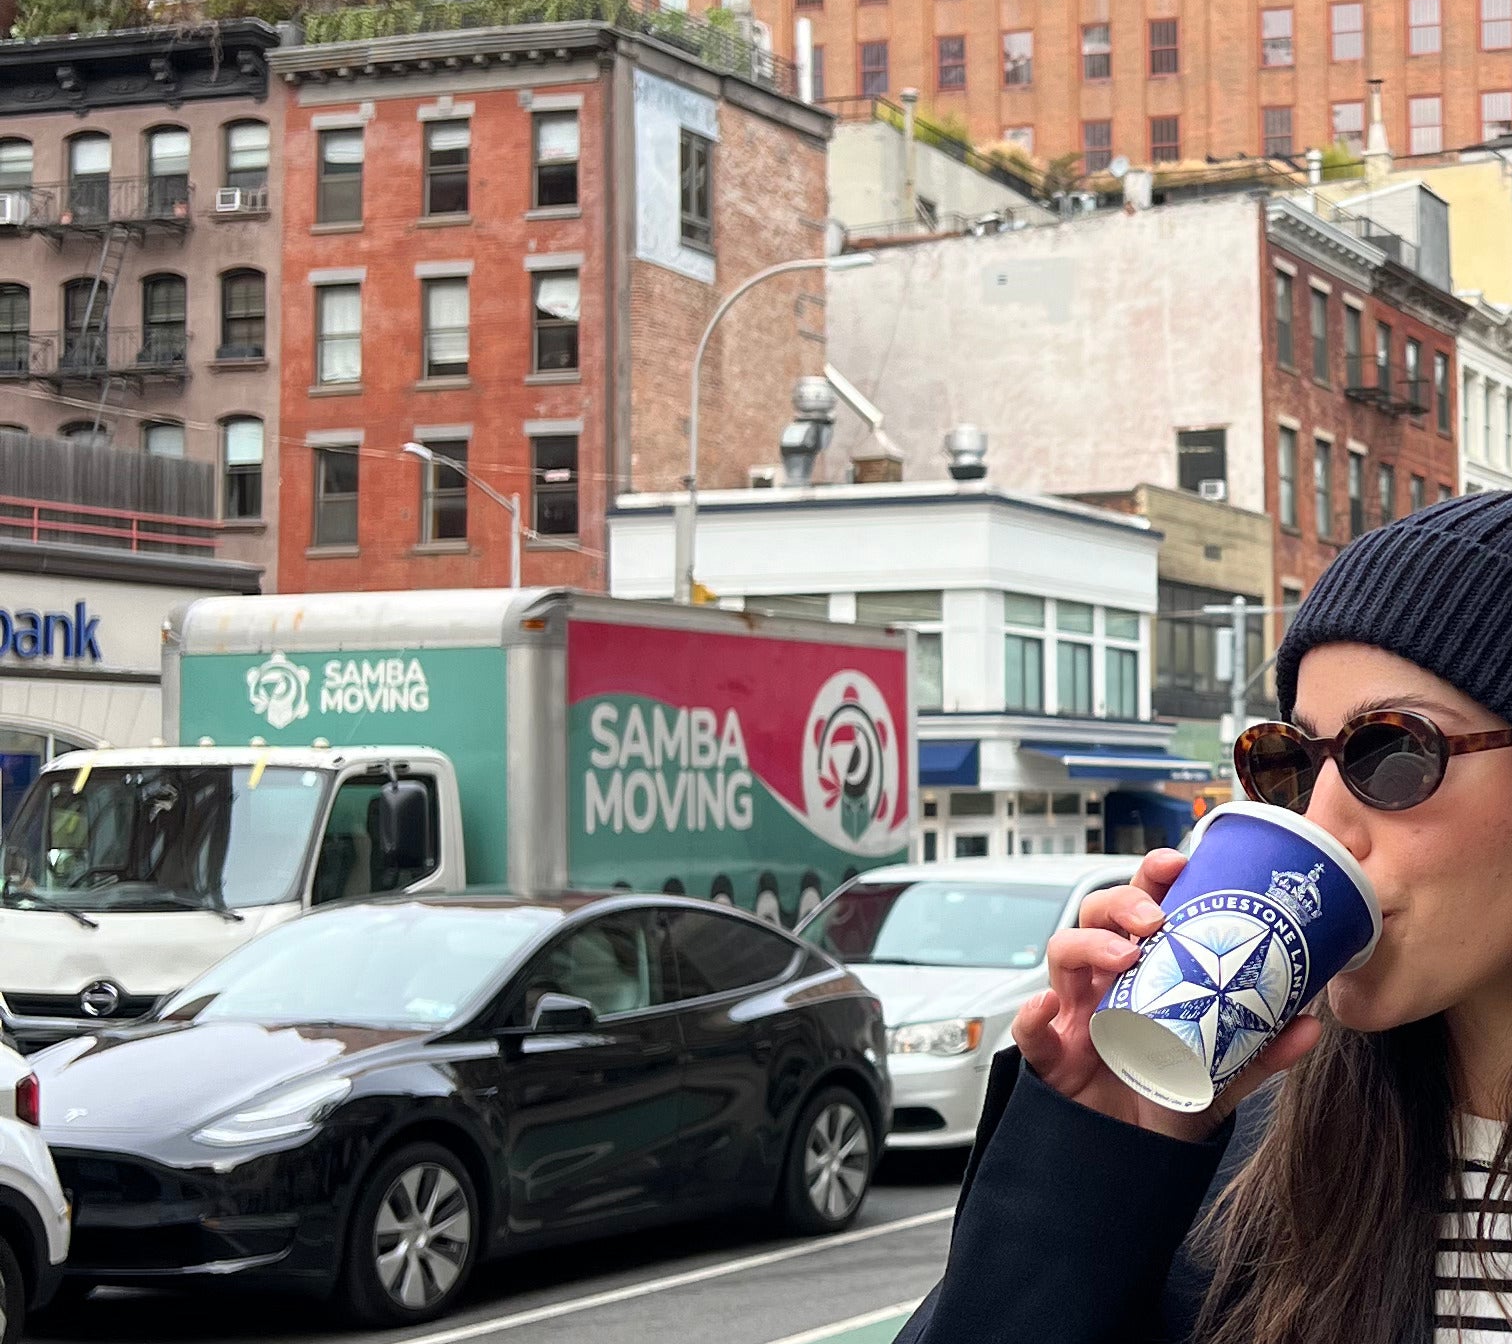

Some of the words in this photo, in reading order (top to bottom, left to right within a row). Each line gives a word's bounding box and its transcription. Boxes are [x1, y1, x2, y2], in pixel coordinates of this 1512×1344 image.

[320, 685, 429, 713] MOVING
[324, 659, 427, 687] SAMBA
[590, 703, 750, 770] SAMBA
[584, 769, 754, 834] MOVING
[1187, 896, 1297, 944] BLUESTONE
[1289, 948, 1304, 1002] LANE
